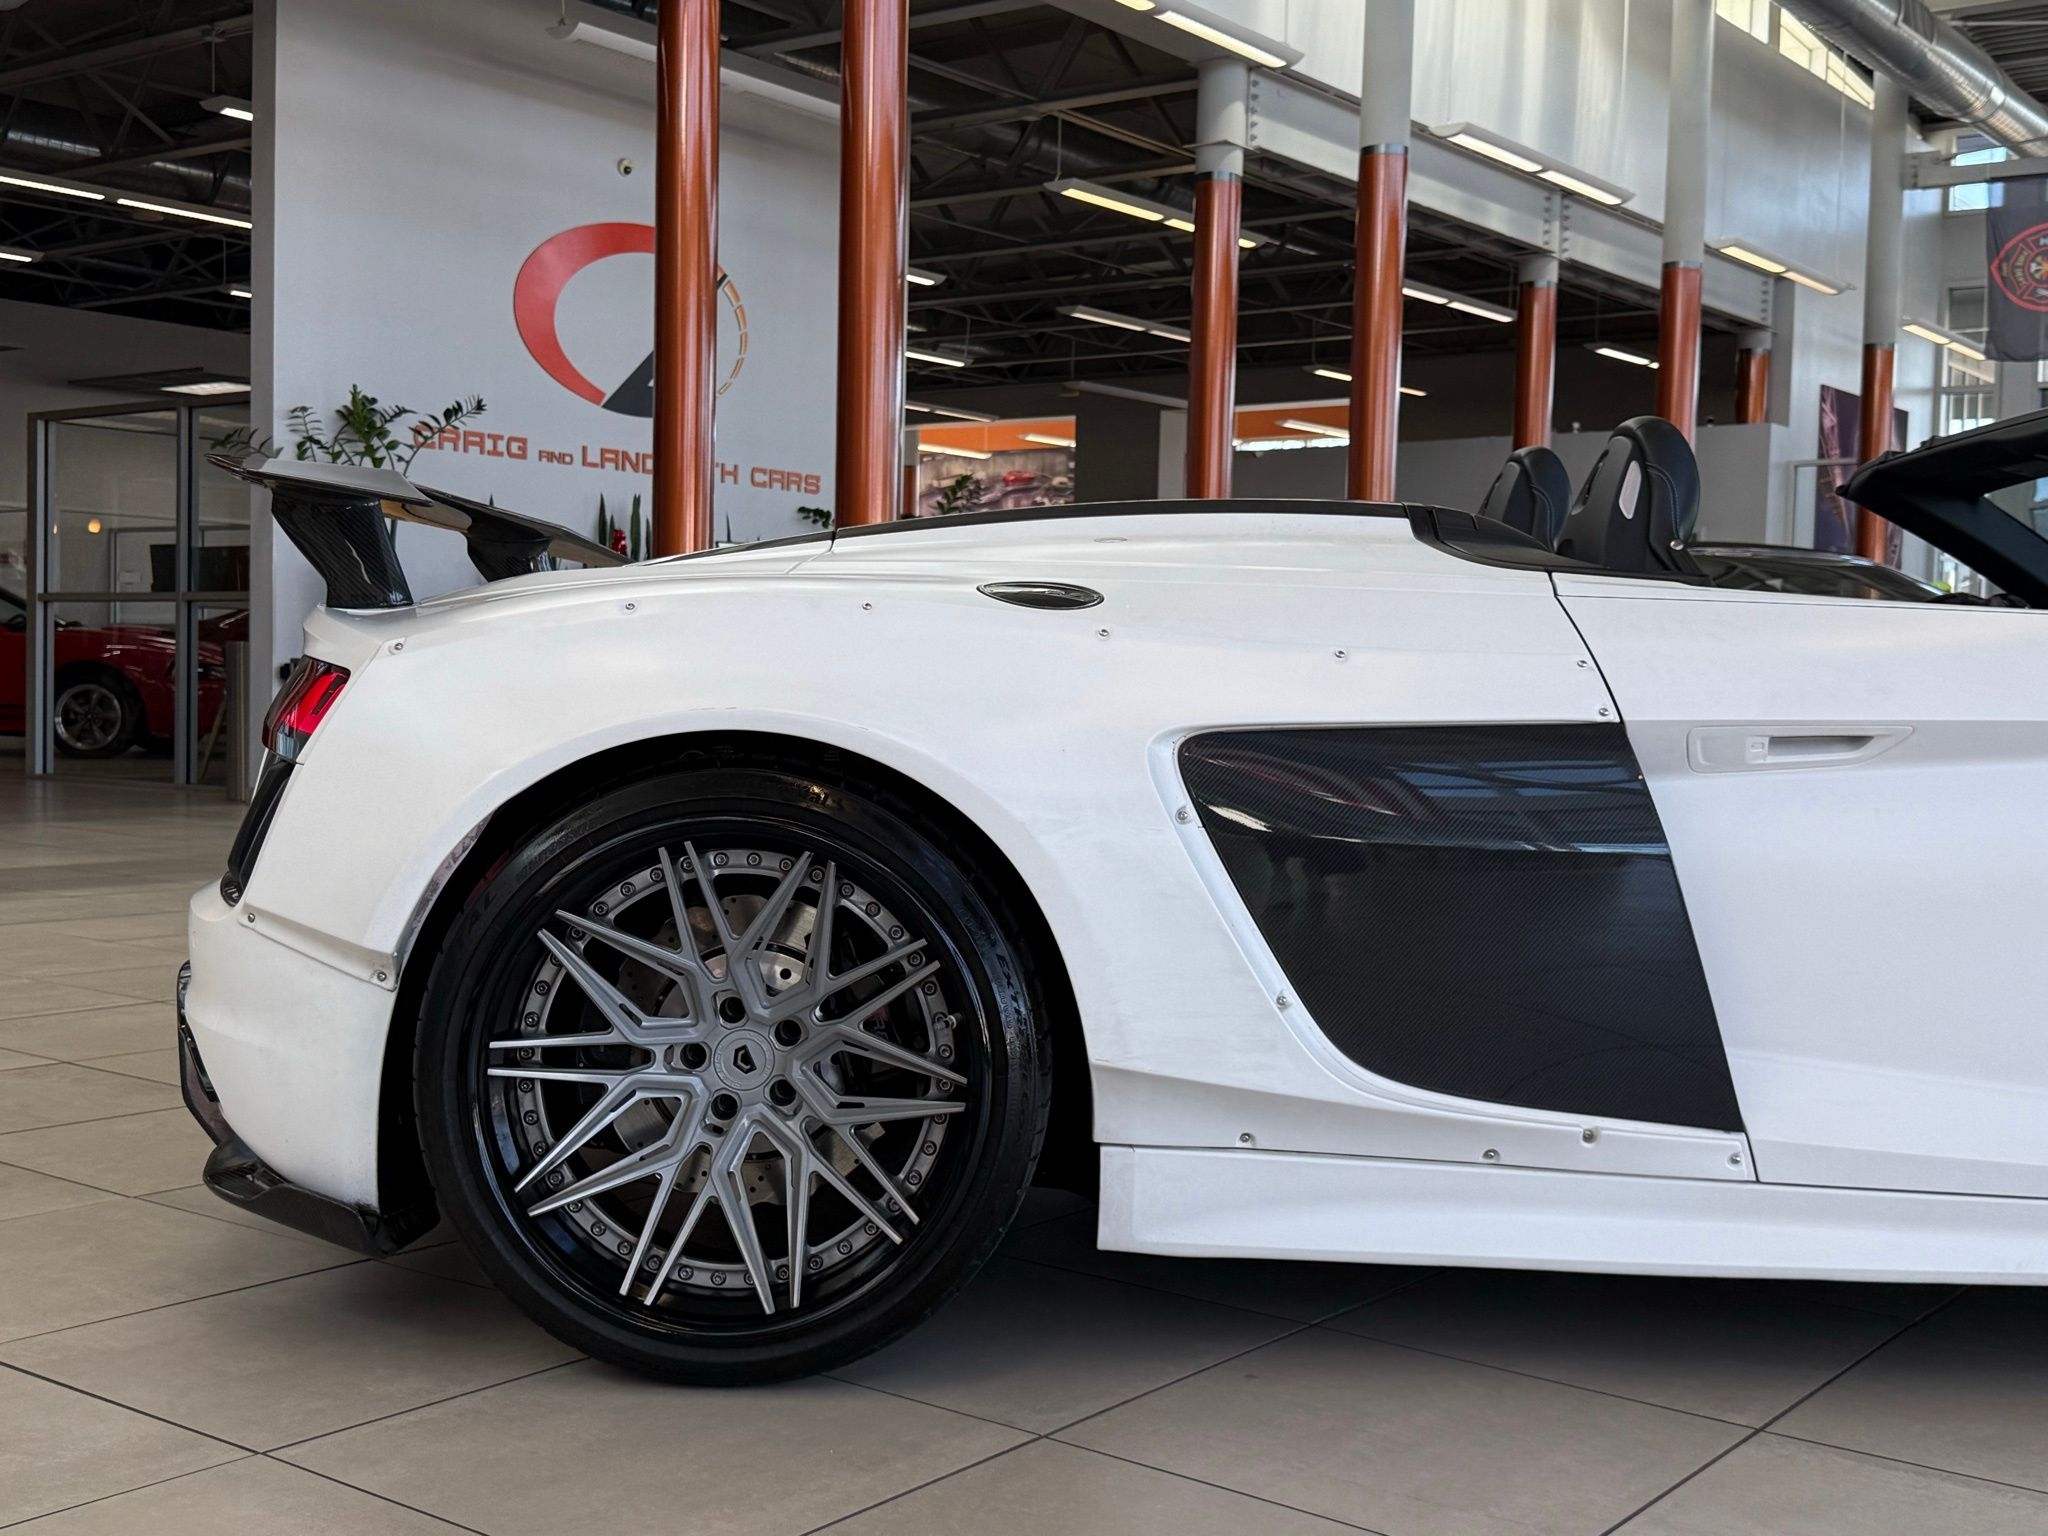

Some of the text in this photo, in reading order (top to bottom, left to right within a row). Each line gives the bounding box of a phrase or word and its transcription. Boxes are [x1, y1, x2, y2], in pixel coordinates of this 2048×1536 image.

[413, 424, 528, 460] CRAIG
[538, 450, 573, 465] AND
[751, 466, 821, 495] CARS
